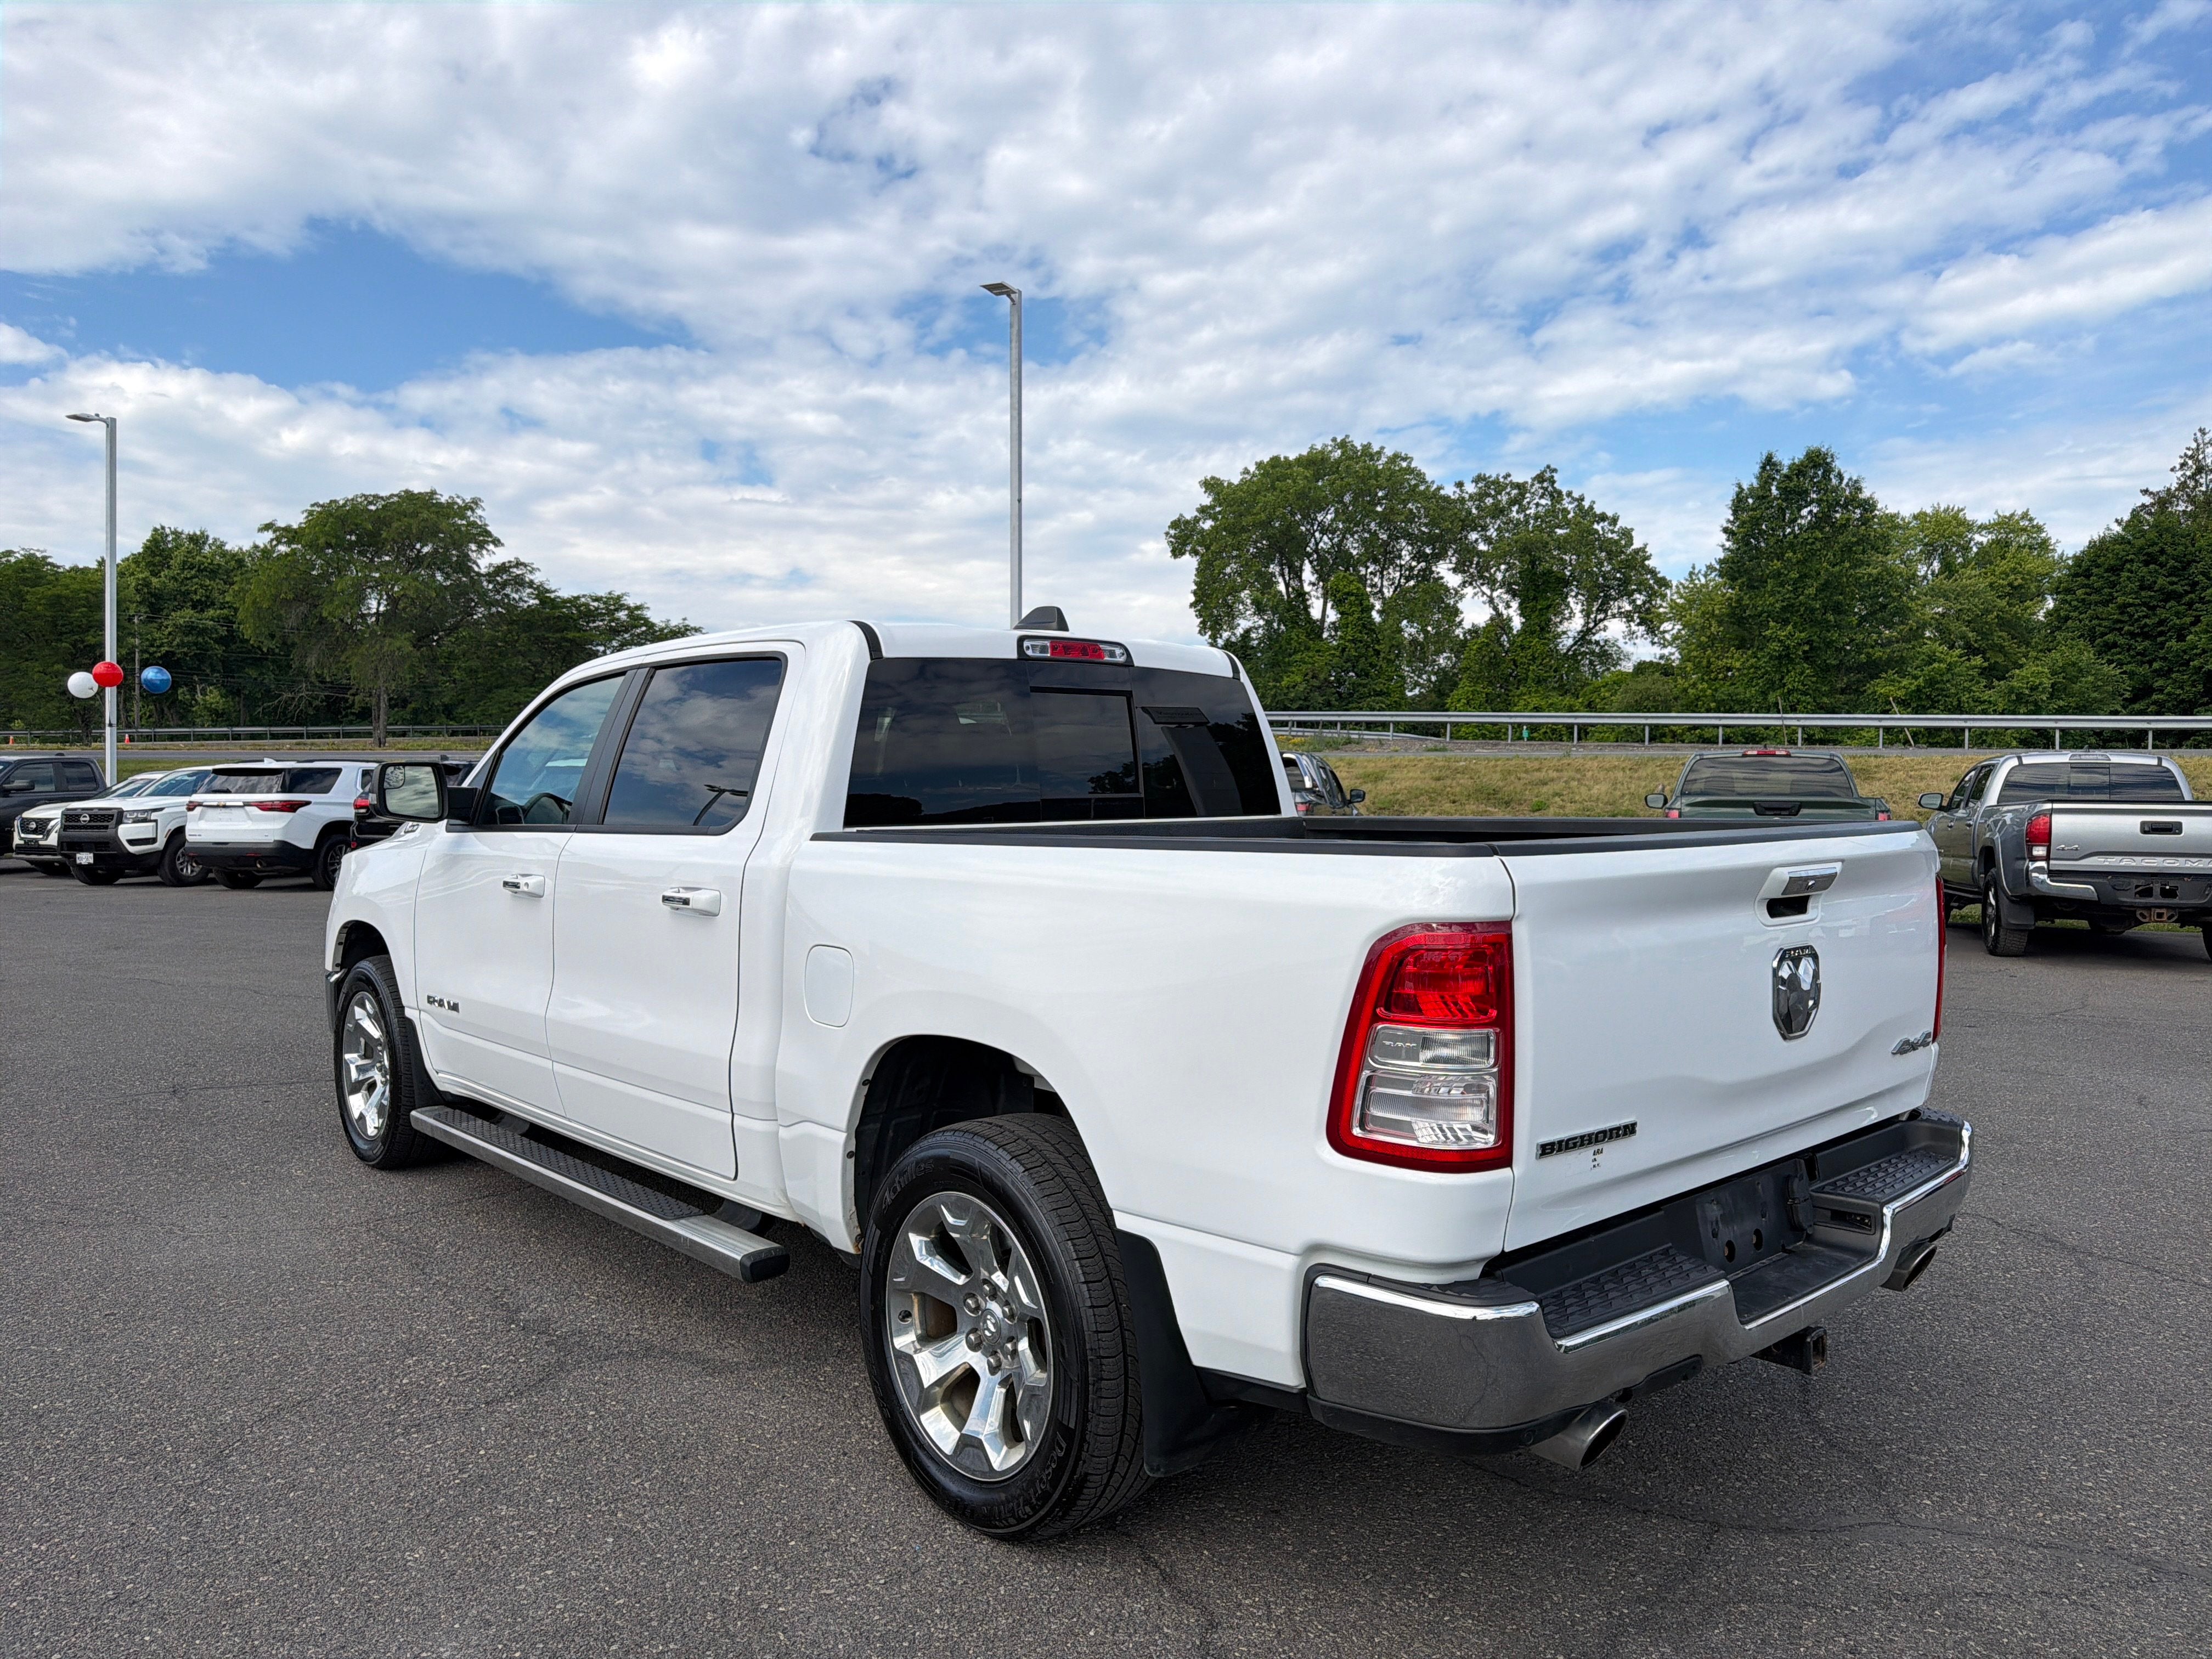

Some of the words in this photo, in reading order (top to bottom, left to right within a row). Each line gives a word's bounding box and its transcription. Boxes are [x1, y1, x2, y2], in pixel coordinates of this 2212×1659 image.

[1785, 946, 1812, 958] RAM
[427, 994, 460, 1014] RAM
[1538, 1121, 1638, 1159] BIGHORN
